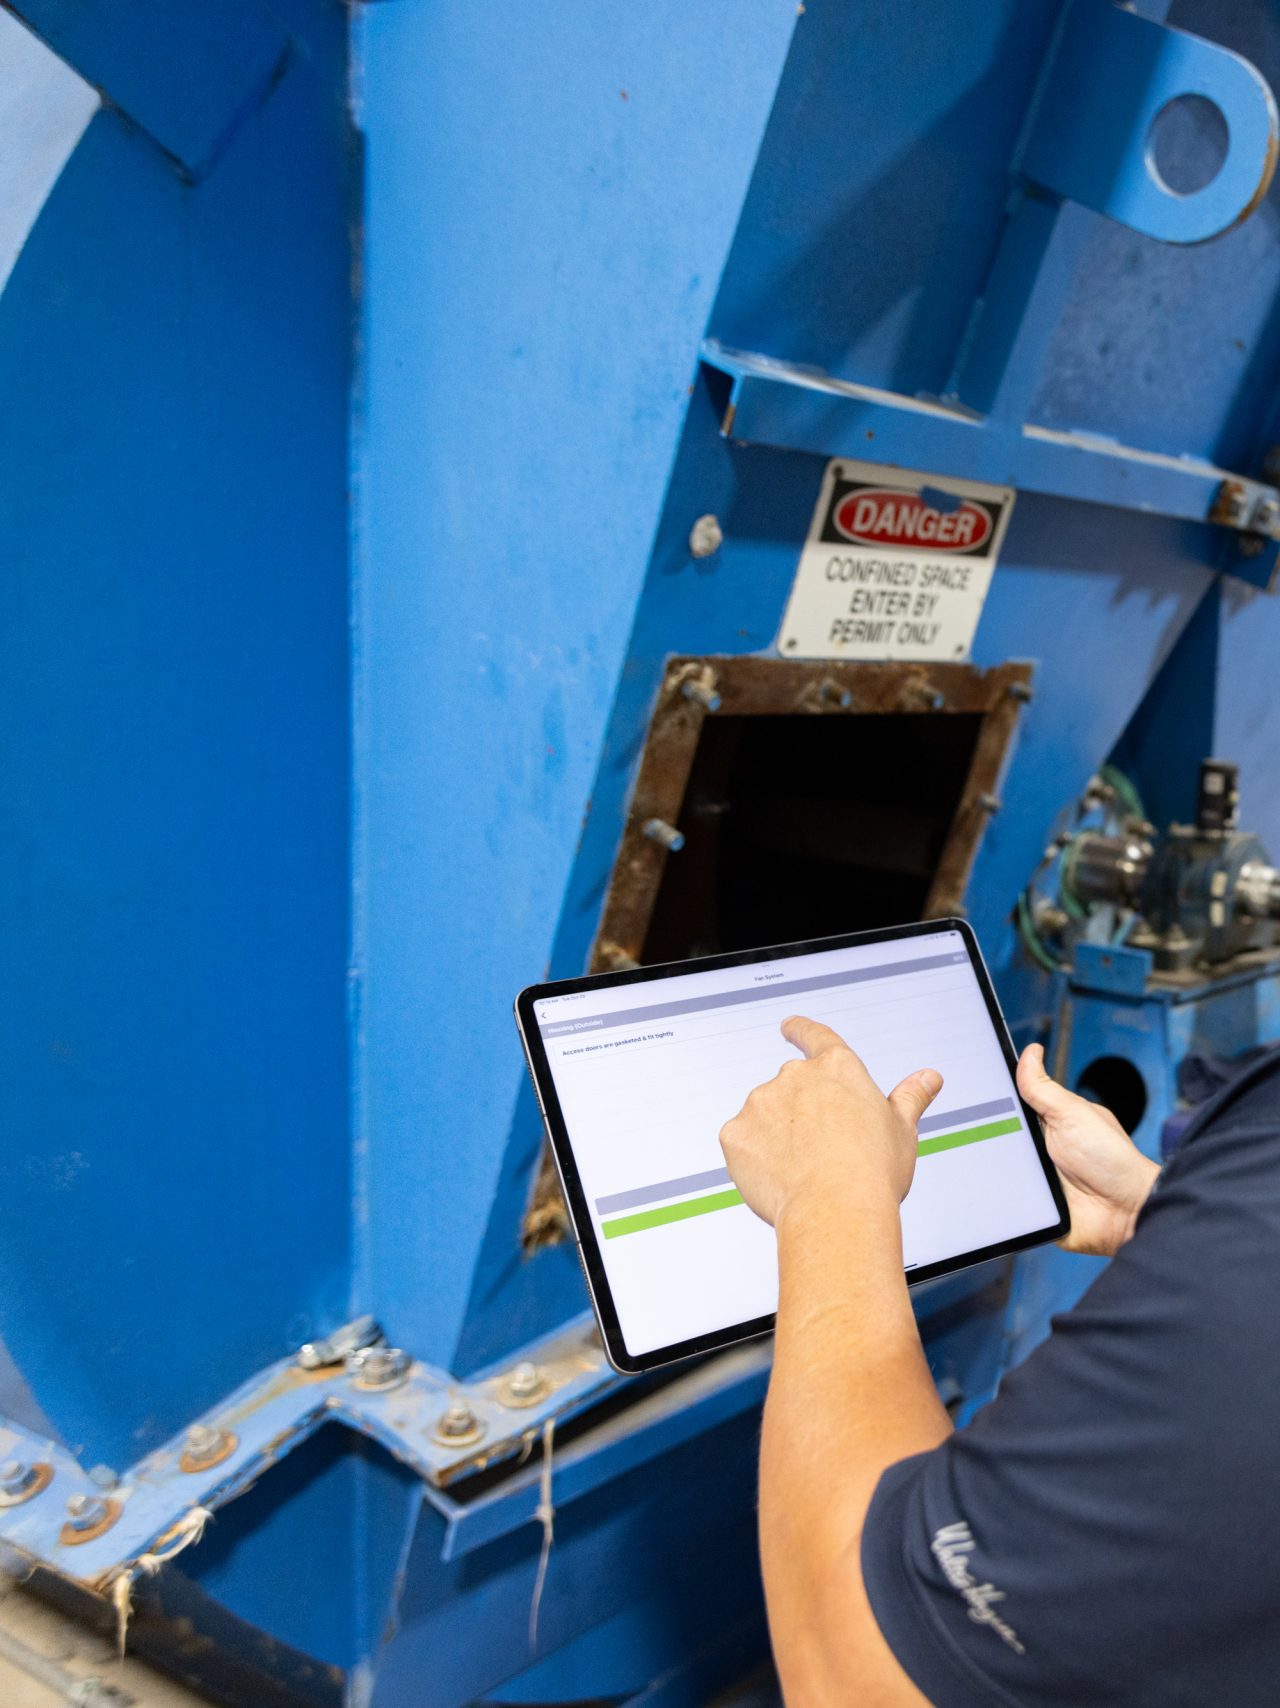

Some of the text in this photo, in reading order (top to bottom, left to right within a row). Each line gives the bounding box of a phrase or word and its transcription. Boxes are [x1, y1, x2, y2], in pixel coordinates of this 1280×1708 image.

[852, 499, 978, 544] DANGER
[825, 555, 972, 592] CONFINED SPACE
[849, 589, 939, 618] ENTER BY
[828, 618, 941, 646] PERMIT ONLY
[562, 1047, 584, 1056] Access
[585, 1043, 603, 1052] doors
[614, 1036, 642, 1048] gasketed
[655, 1030, 674, 1040] tightly
